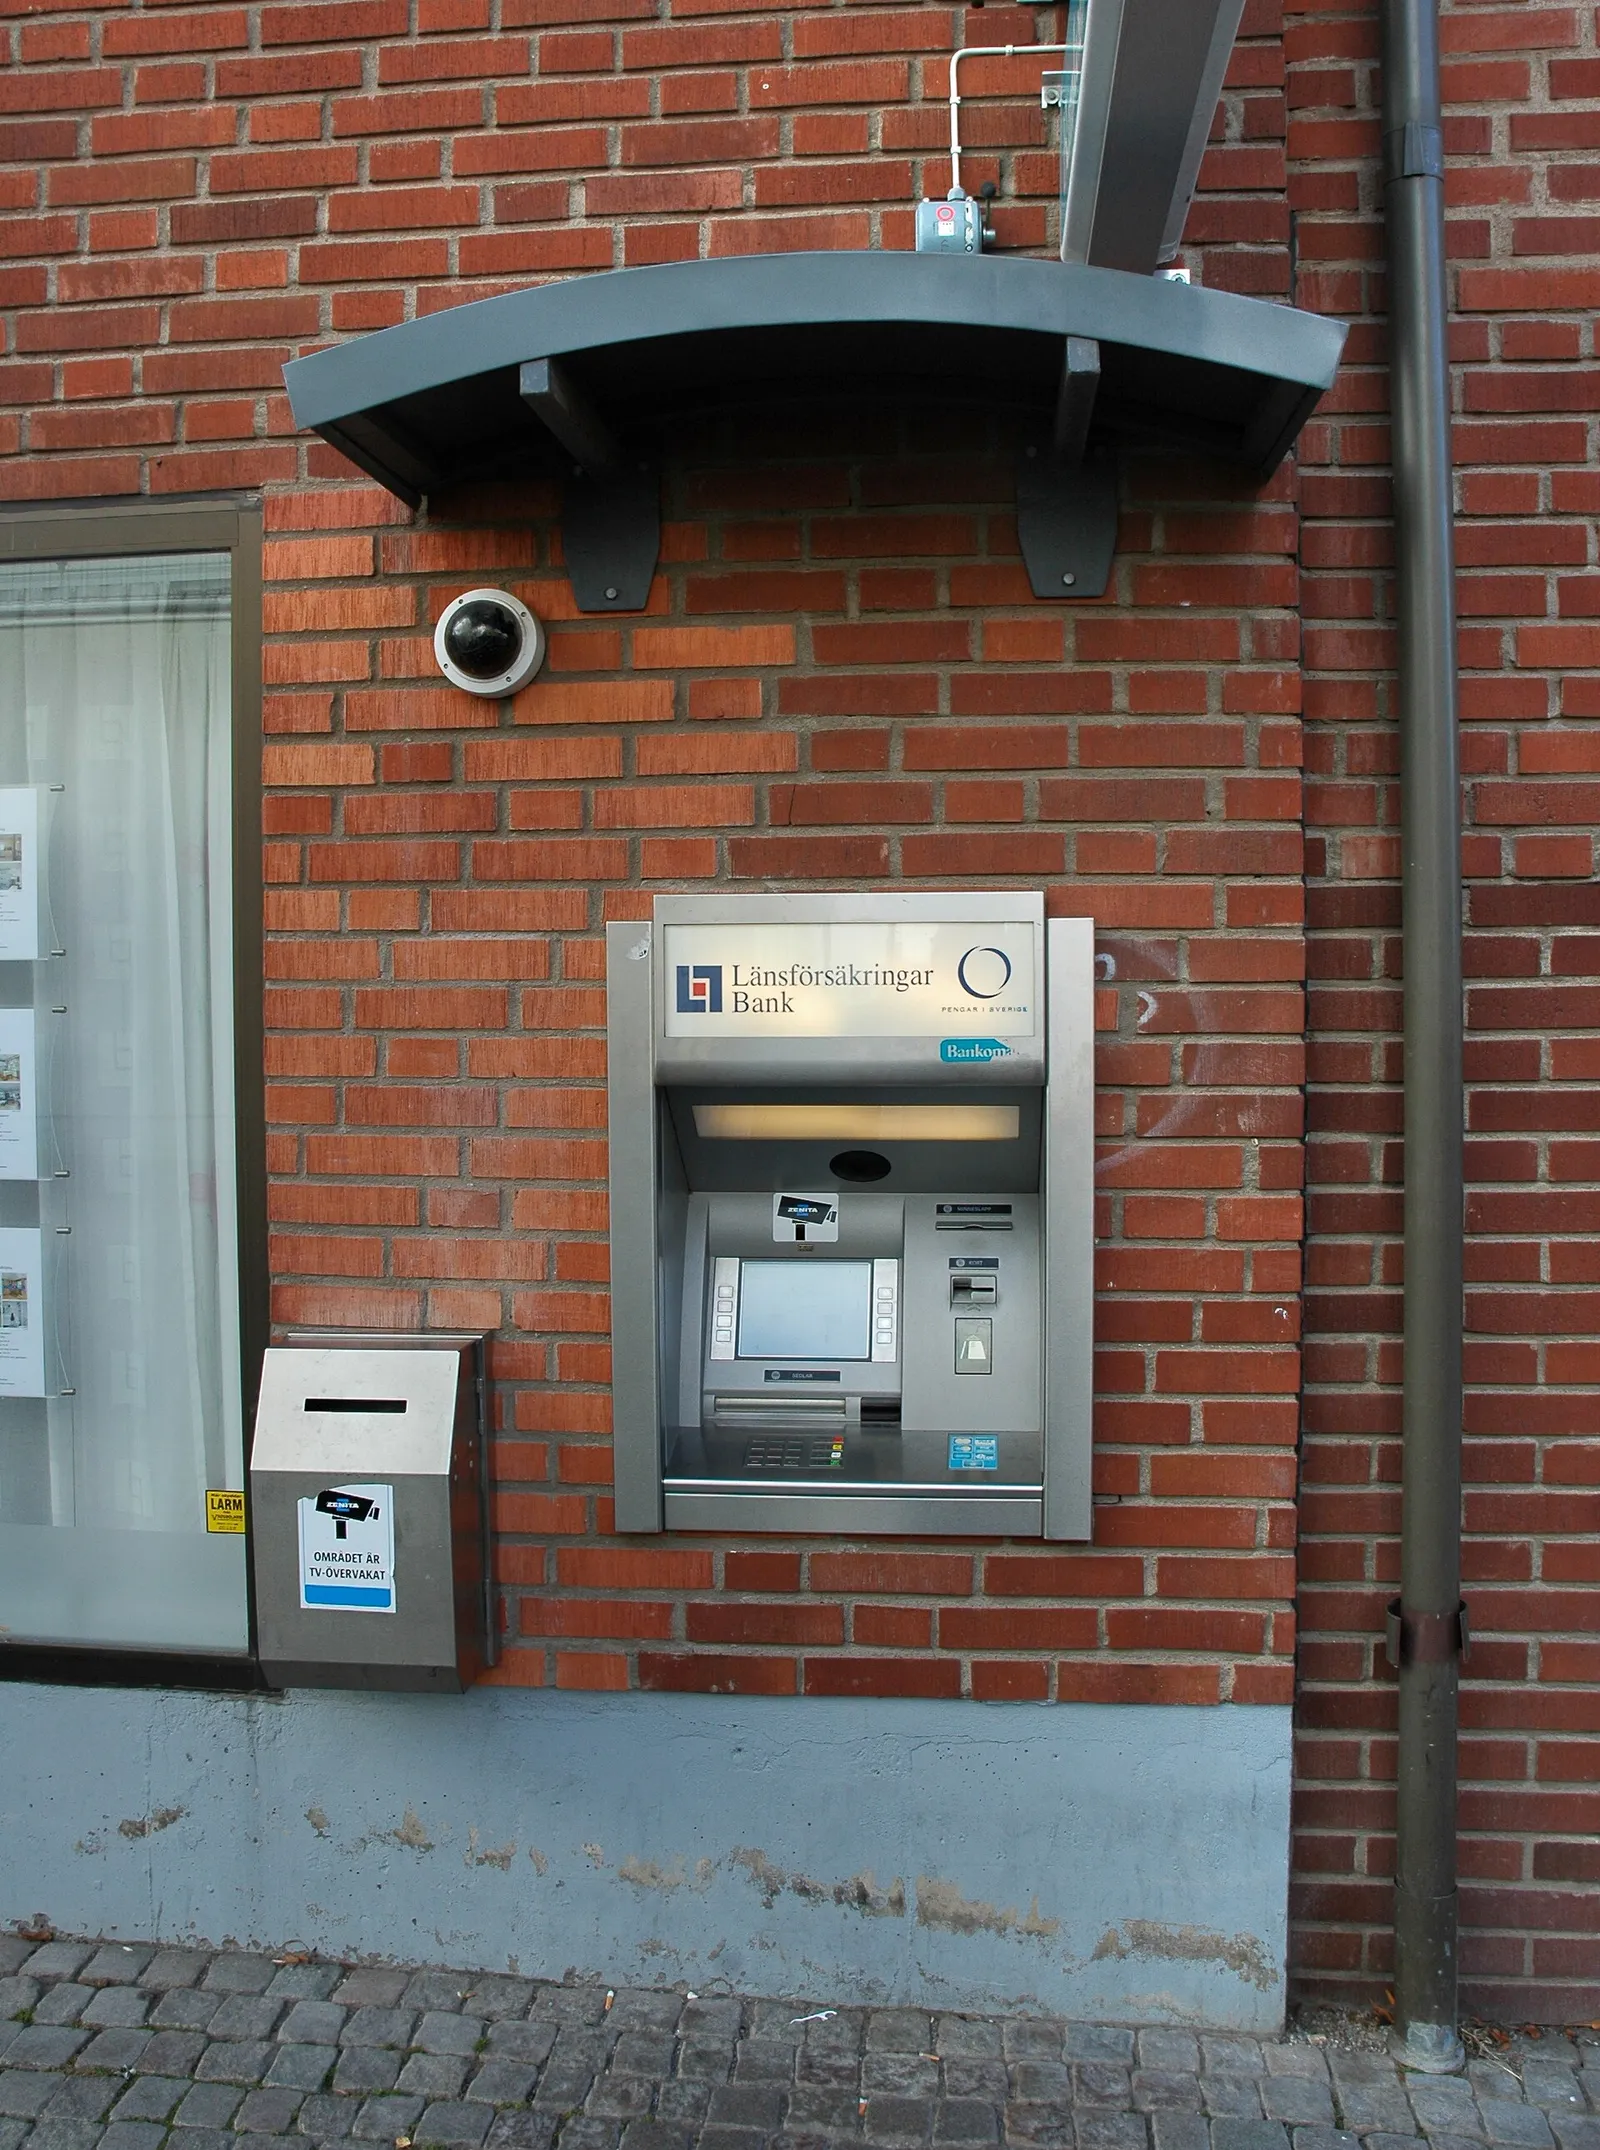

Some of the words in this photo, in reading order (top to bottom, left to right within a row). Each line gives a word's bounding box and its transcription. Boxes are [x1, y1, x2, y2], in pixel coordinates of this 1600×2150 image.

[732, 963, 934, 992] Länsförsäkringar
[733, 991, 794, 1014] Bank
[211, 1498, 242, 1511] LARM
[326, 1501, 360, 1509] ZENITA
[314, 1551, 363, 1564] OMRÅDET
[366, 1552, 380, 1565] ÄR
[309, 1566, 386, 1581] TV-ÖVERVAKAT
